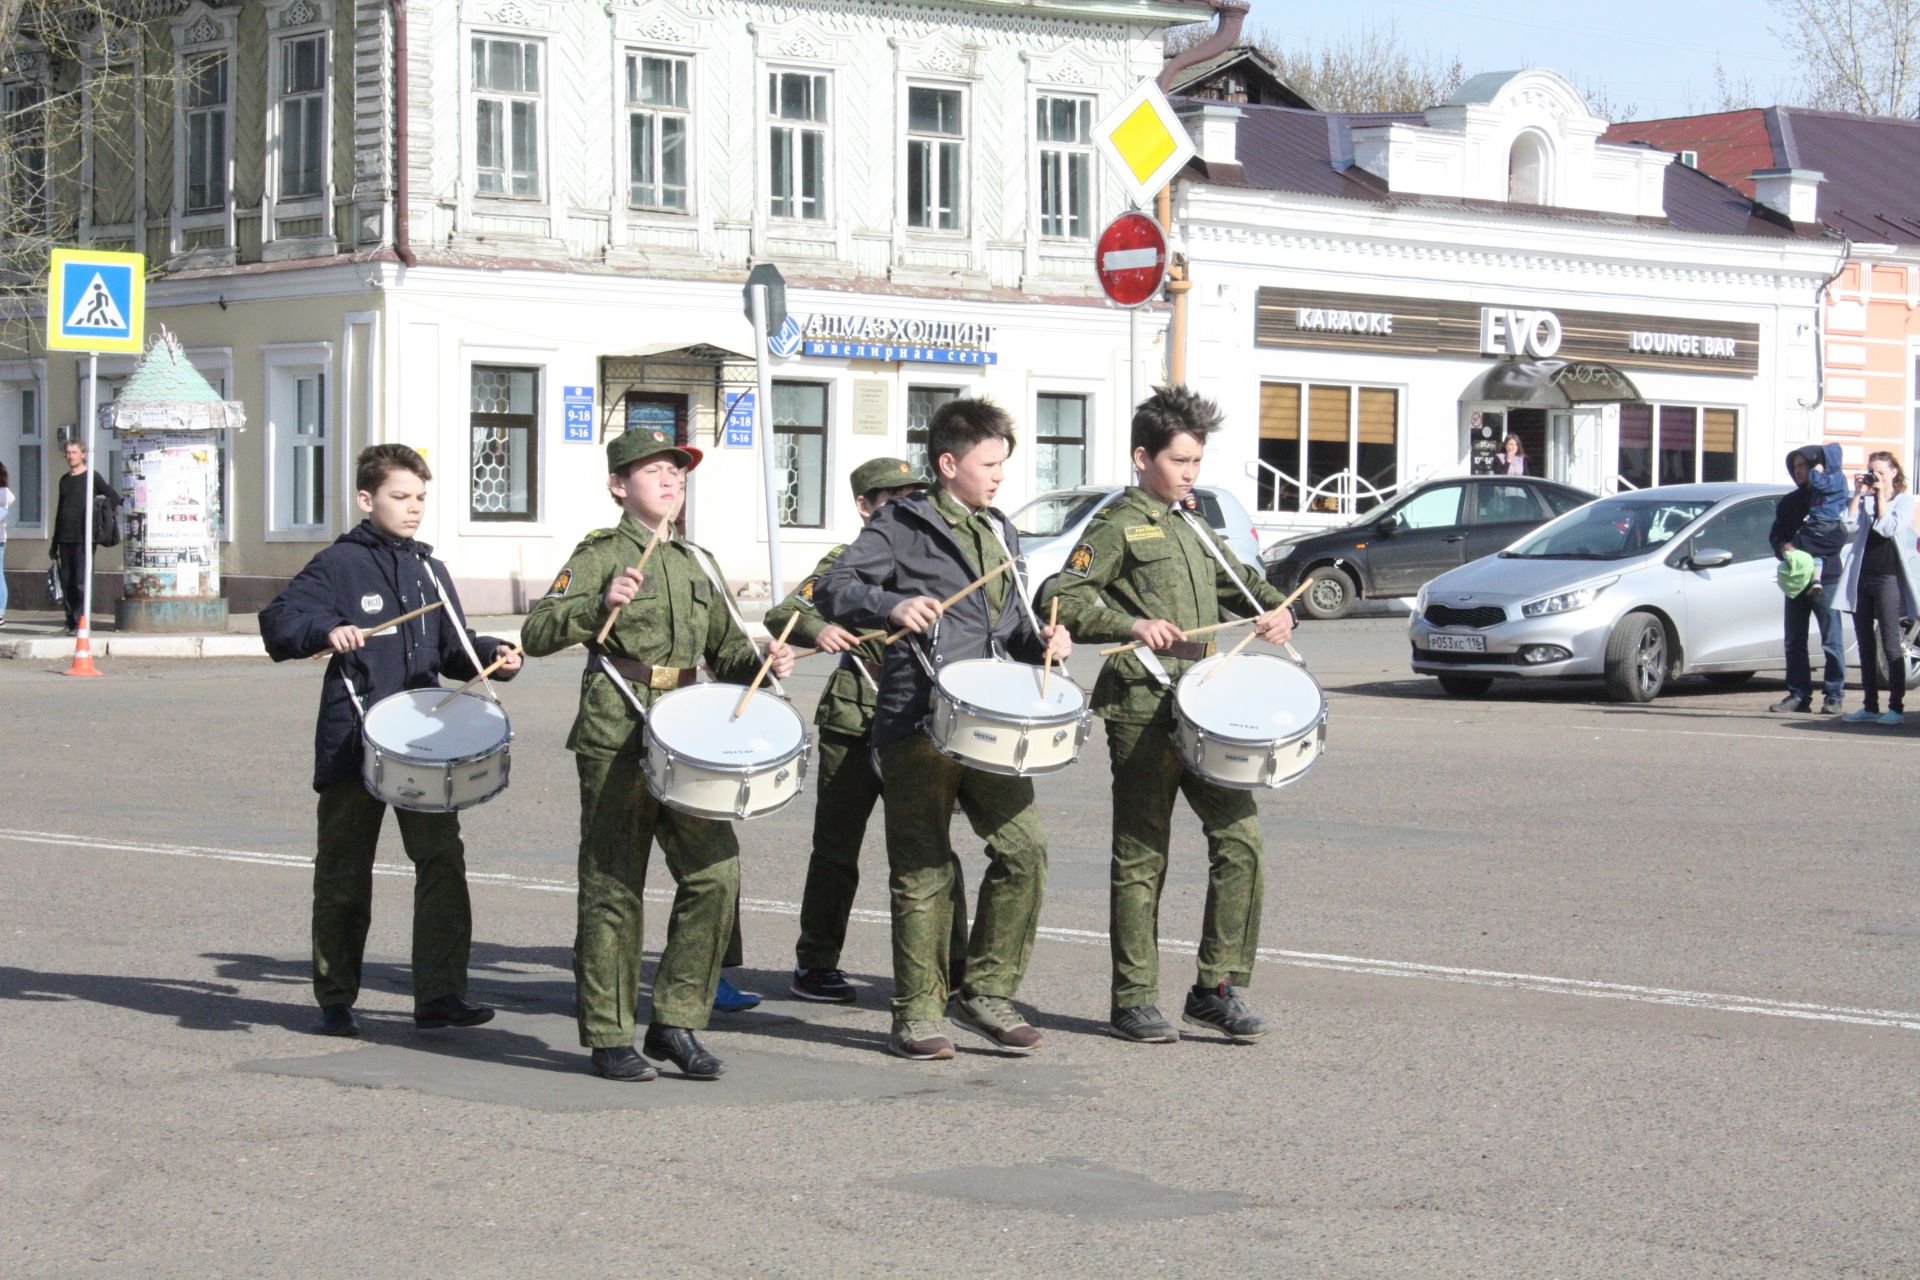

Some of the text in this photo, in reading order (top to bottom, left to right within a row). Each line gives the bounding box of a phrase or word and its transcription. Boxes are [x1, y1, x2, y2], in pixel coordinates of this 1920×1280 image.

[1296, 307, 1393, 333] KARAOKE
[1480, 307, 1562, 358] EVO
[1629, 331, 1736, 358] LOUNGE BAR
[812, 343, 992, 364] ювелирная сеть
[568, 410, 590, 422] 9-18
[730, 416, 751, 427] 9-18
[570, 428, 589, 438] 9-16
[731, 433, 750, 443] 9-16
